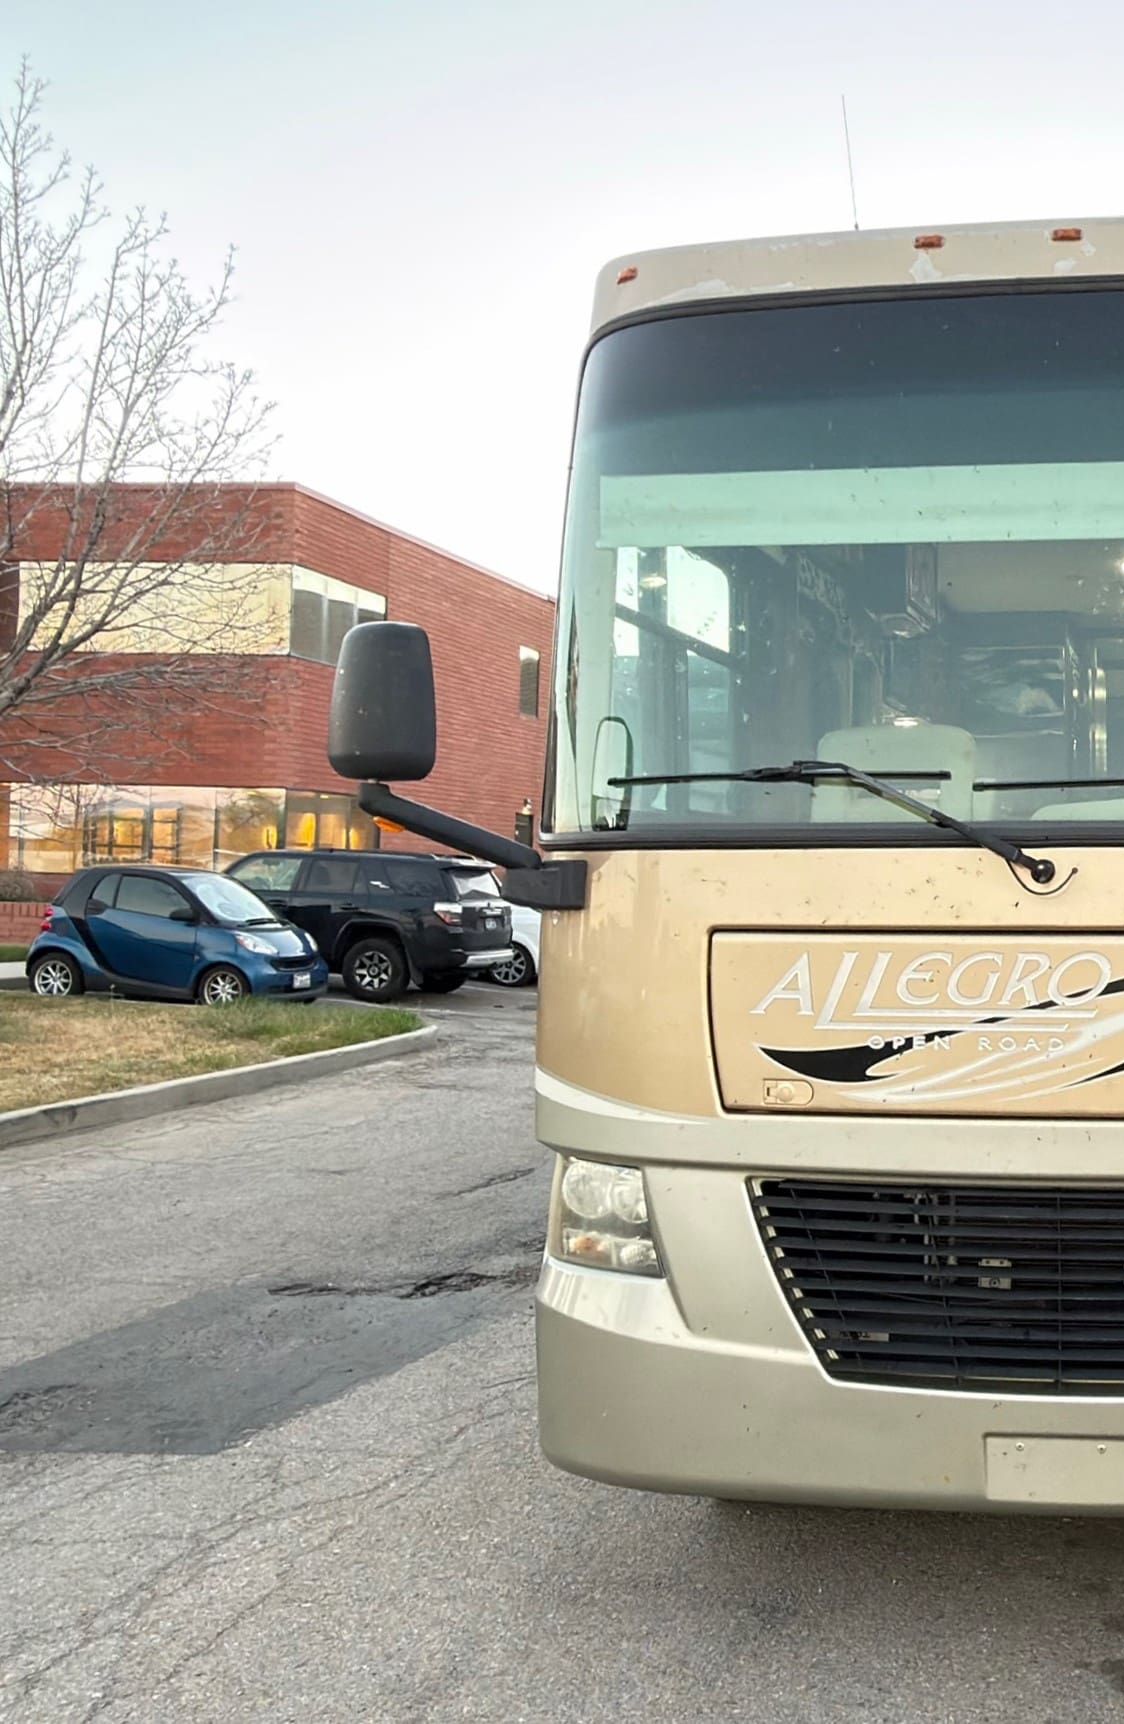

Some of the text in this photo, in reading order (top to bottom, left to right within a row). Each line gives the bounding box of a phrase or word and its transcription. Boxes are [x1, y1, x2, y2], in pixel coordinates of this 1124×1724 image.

[749, 951, 1113, 1030] ALLEGRO
[866, 1034, 1065, 1051] OPEN ROAD
